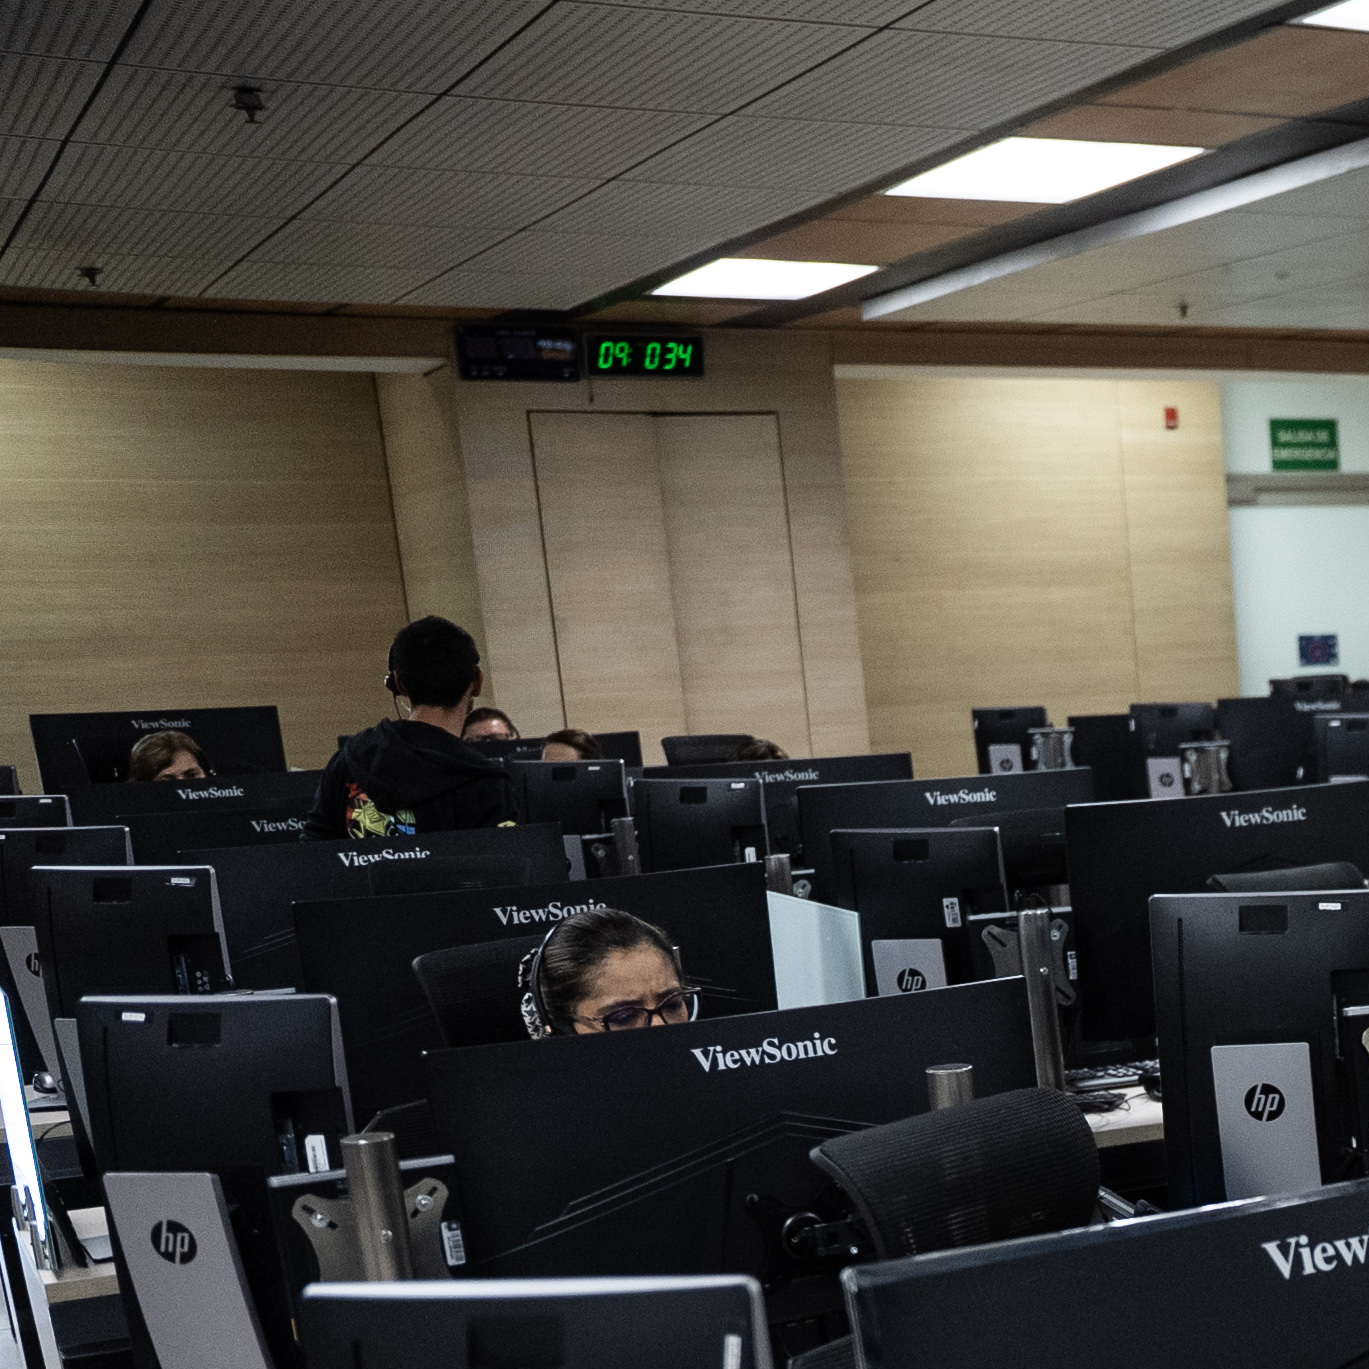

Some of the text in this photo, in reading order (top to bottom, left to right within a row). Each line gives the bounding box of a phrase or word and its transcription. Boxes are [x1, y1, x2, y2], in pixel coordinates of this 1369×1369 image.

[131, 718, 193, 730] ViewSonic
[177, 785, 245, 800] ViewSonic
[926, 787, 998, 806] ViewSonic
[1220, 804, 1308, 828] ViewSonic
[899, 968, 924, 993] hp
[691, 1032, 839, 1073] ViewSonic
[1247, 1083, 1283, 1122] hp
[155, 1220, 194, 1264] hp
